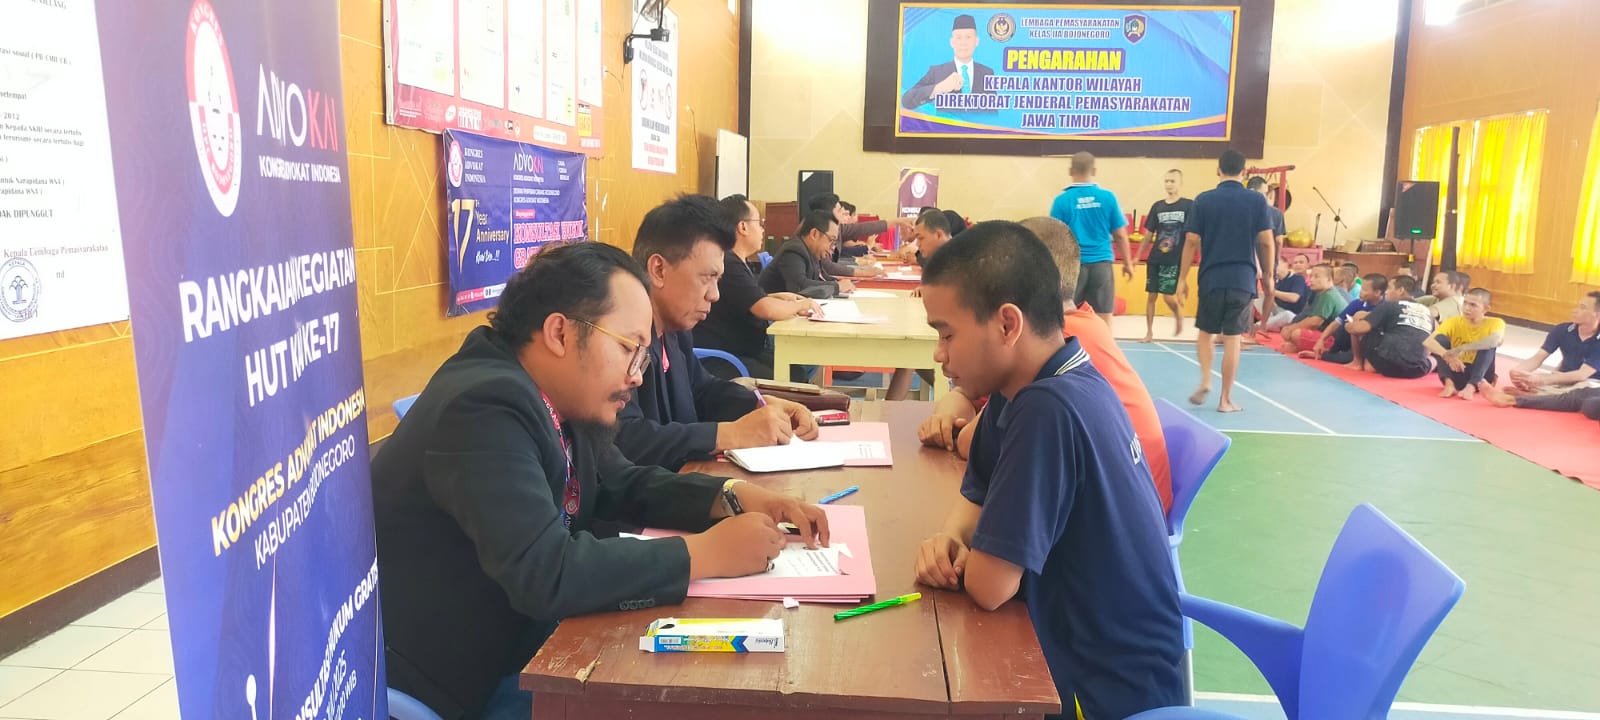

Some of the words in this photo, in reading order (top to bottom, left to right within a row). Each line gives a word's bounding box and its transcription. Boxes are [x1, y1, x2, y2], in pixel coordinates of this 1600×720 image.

[1021, 17, 1054, 27] LEMBAGA
[1055, 18, 1120, 28] PEMASYARAKATAN
[1029, 29, 1051, 38] KELAS
[1063, 30, 1110, 39] BOJONEGORO
[1007, 49, 1121, 71] PENGARAHAN
[984, 76, 1029, 91] KEPALA
[1032, 76, 1083, 91] KANTOR
[1085, 77, 1141, 92] WILAYAH
[935, 94, 1011, 109] DIREKTORAT
[1013, 95, 1072, 110] JENDERAL
[1074, 96, 1190, 111] PEMASYARAKATAN
[1021, 113, 1056, 128] JAWA
[1058, 114, 1099, 128] TIMUR
[475, 211, 488, 226] Year
[451, 198, 476, 272] 17
[476, 227, 509, 245] Anniversary
[245, 340, 288, 407] HUT
[302, 312, 339, 367] KE-17
[211, 462, 285, 557] KONGRES
